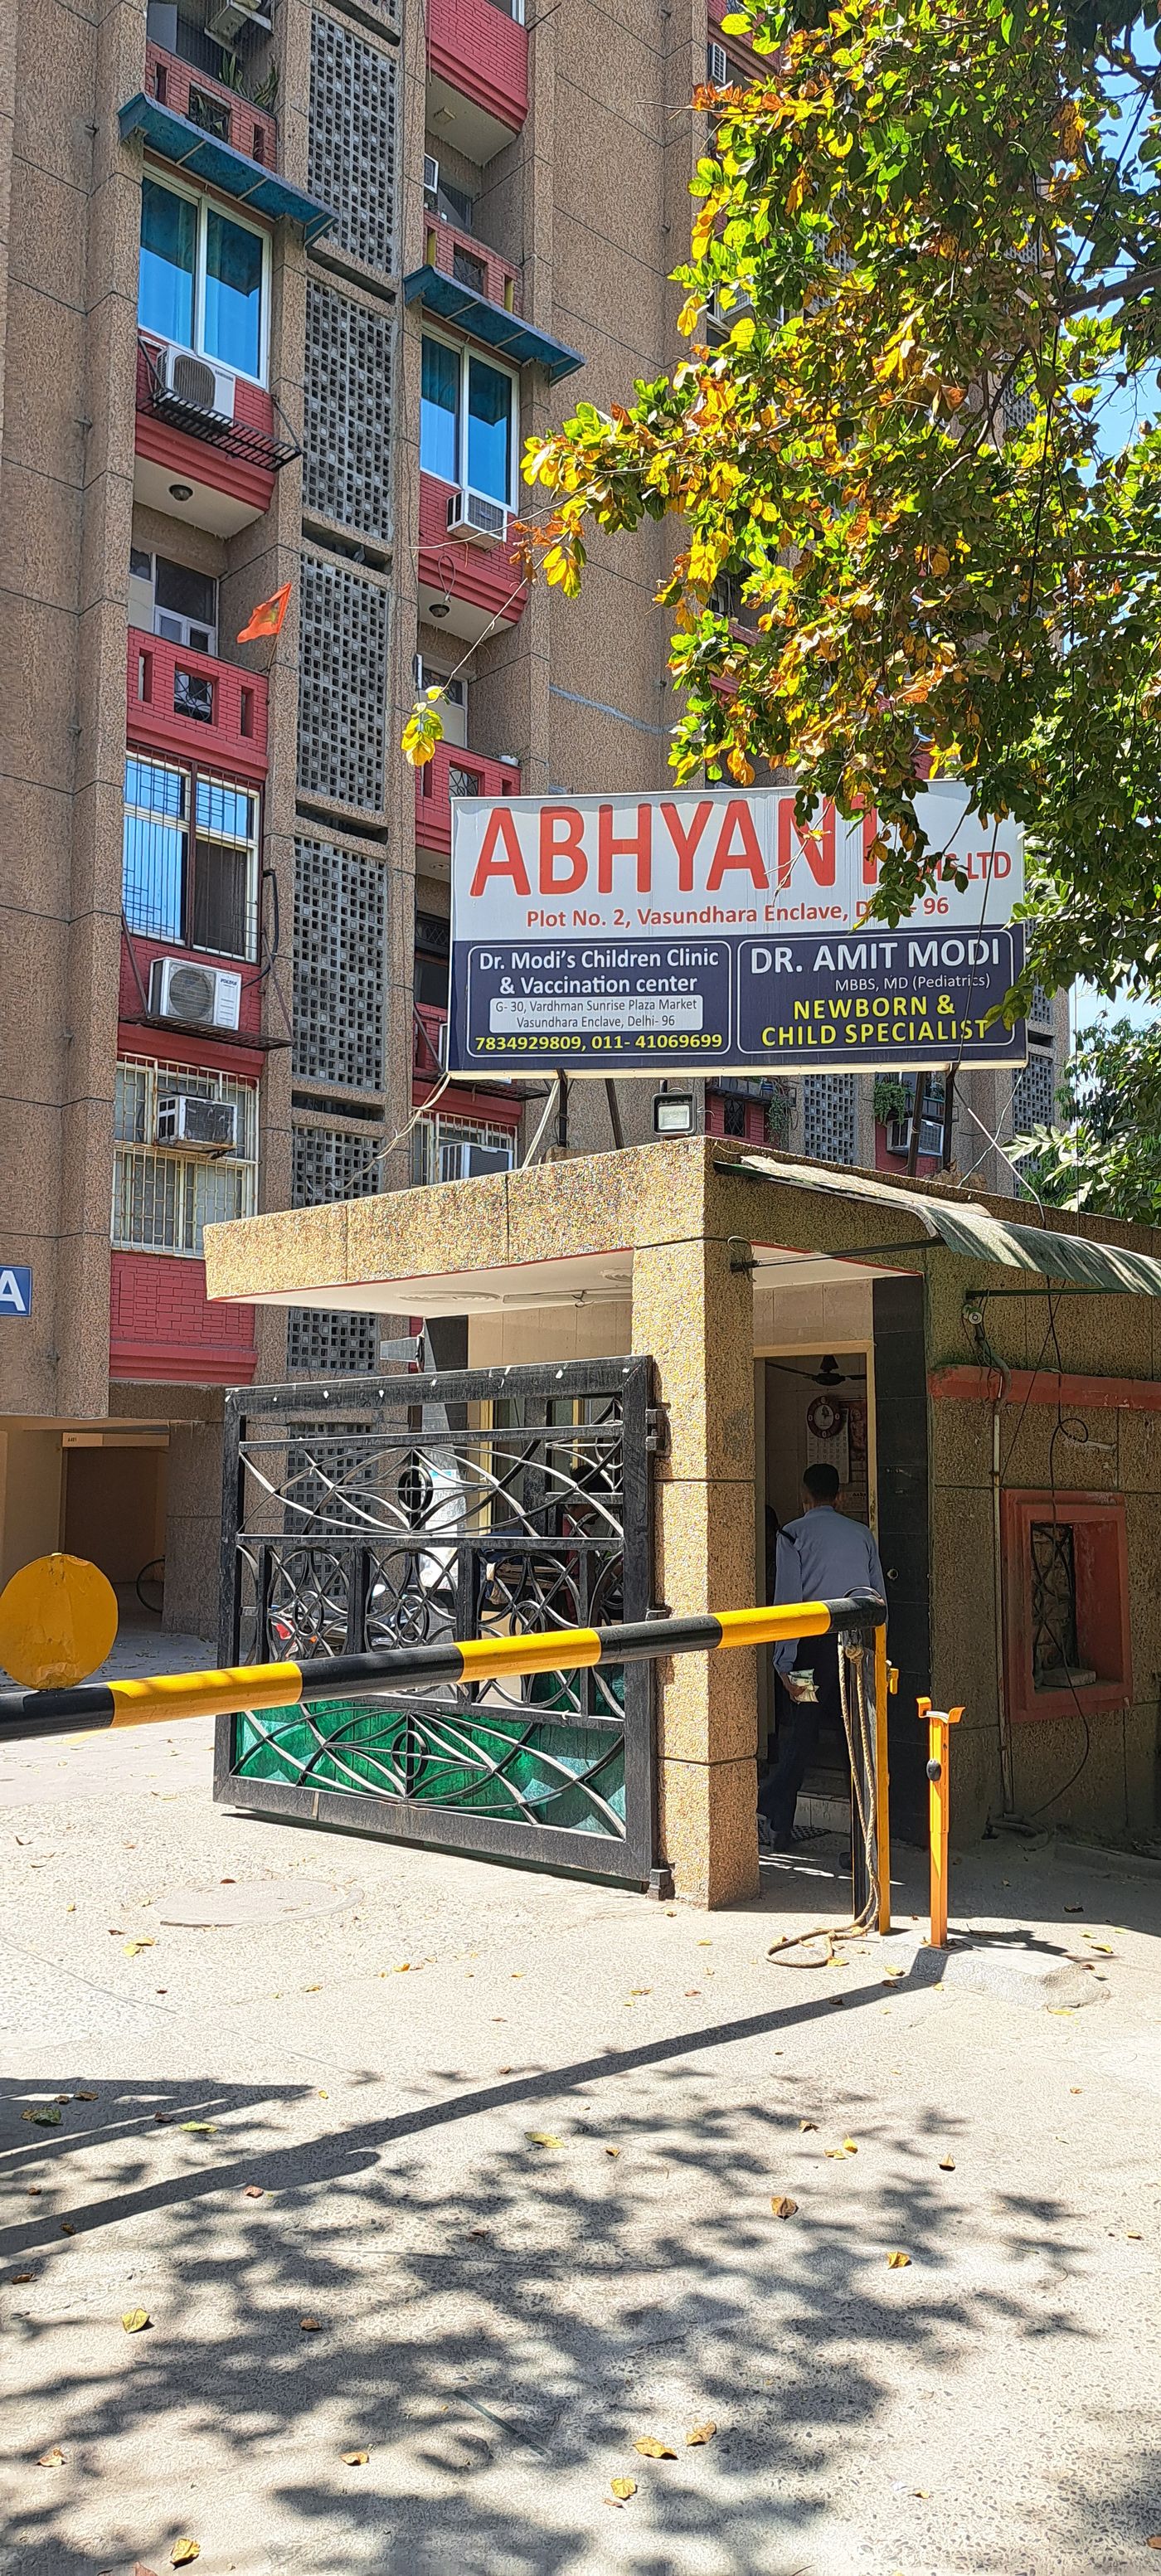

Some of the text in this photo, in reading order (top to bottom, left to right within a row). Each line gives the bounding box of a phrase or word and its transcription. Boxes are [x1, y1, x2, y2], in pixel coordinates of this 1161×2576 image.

[469, 793, 894, 897] ABHYANT
[967, 851, 1012, 880] LTD
[527, 910, 566, 927] Plot
[572, 910, 606, 927] No.
[613, 908, 631, 929] 2,
[637, 906, 757, 926] Vasundhara
[765, 904, 848, 922] Enclave,
[923, 897, 949, 915] 96
[479, 948, 719, 970] Dr. Modi's Children Clinic
[751, 938, 999, 974] DR. AMIT MODI
[499, 975, 698, 995] & Vaccination center
[835, 973, 991, 993] MBBS, MD (Pediatrics)
[495, 998, 697, 1014] G- 30, Vardhman Sunrise Plaza Market
[794, 994, 955, 1021] NEWBORN &
[517, 1014, 676, 1029] Vasundhara Enclave, Delhi- 96
[760, 1018, 989, 1047] CHILD SPECIALIST
[475, 1033, 722, 1052] 7834929809, 011- 41069699
[0, 1270, 27, 1311] A
